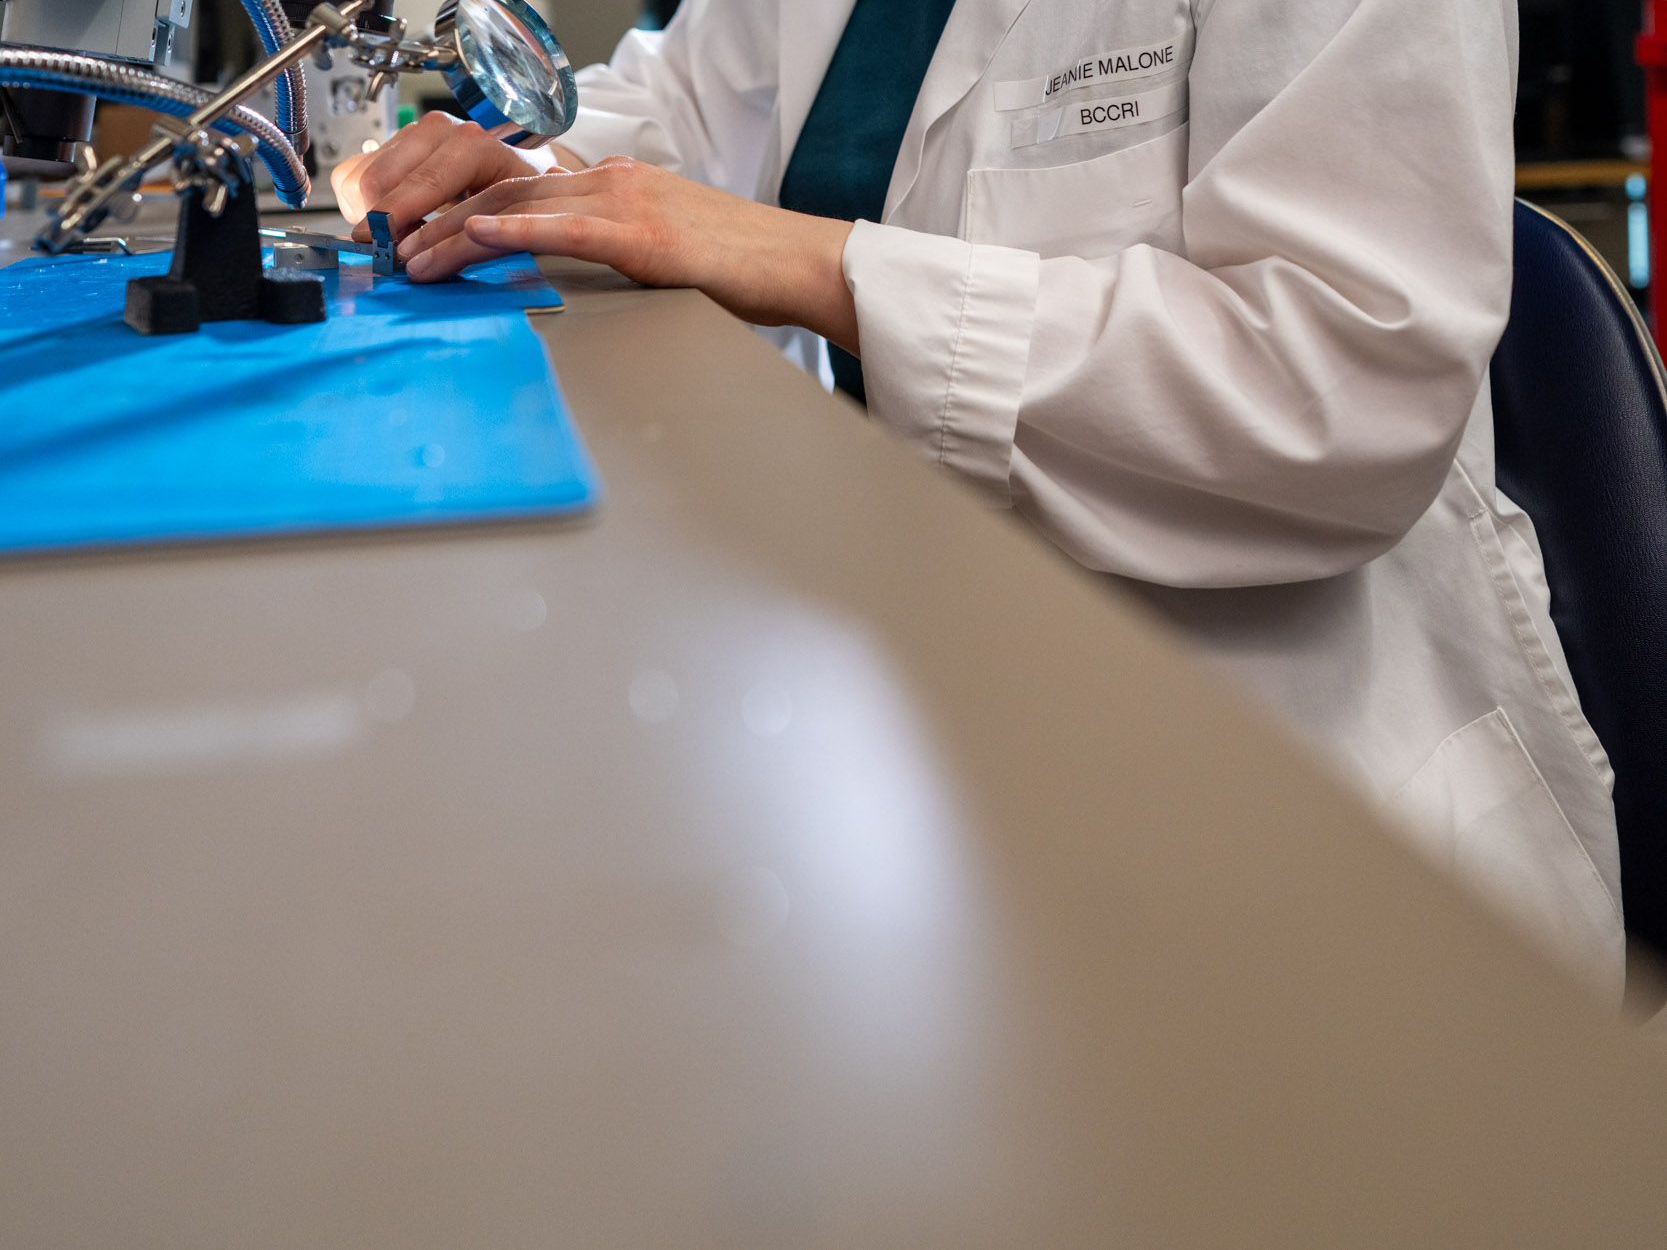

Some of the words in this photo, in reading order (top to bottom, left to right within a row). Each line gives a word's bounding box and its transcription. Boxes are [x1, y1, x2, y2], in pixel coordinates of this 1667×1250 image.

[1045, 62, 1094, 96] JEANIE
[1098, 46, 1174, 75] MALONE
[1080, 101, 1140, 126] BCCRI
